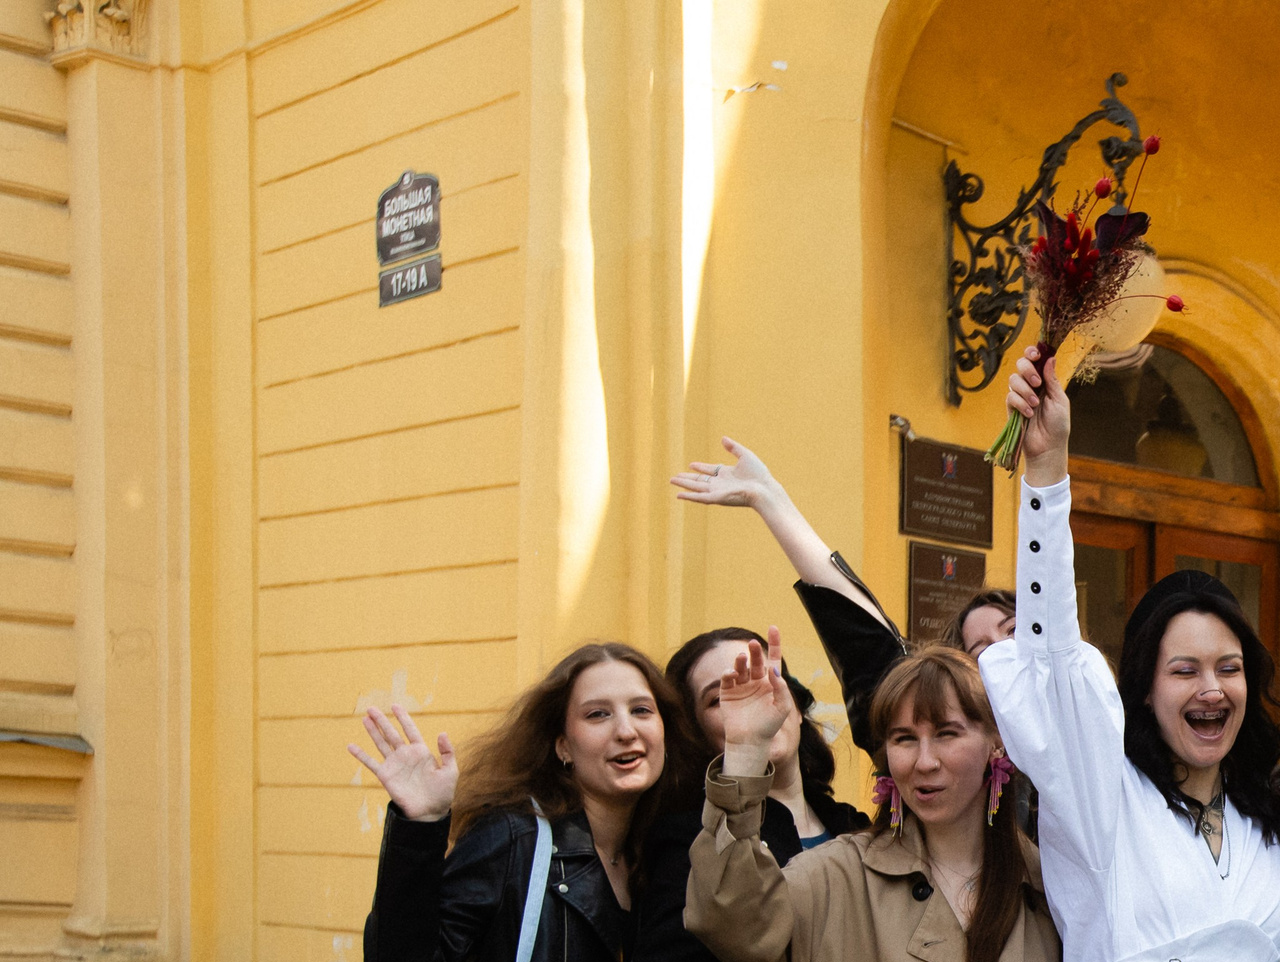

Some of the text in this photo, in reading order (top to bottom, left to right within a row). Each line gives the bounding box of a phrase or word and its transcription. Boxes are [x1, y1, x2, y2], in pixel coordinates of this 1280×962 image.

[384, 185, 432, 217] БОЛЬШАЯ
[382, 204, 434, 238] МОНЕТНАЯ
[390, 267, 418, 297] 17-19
